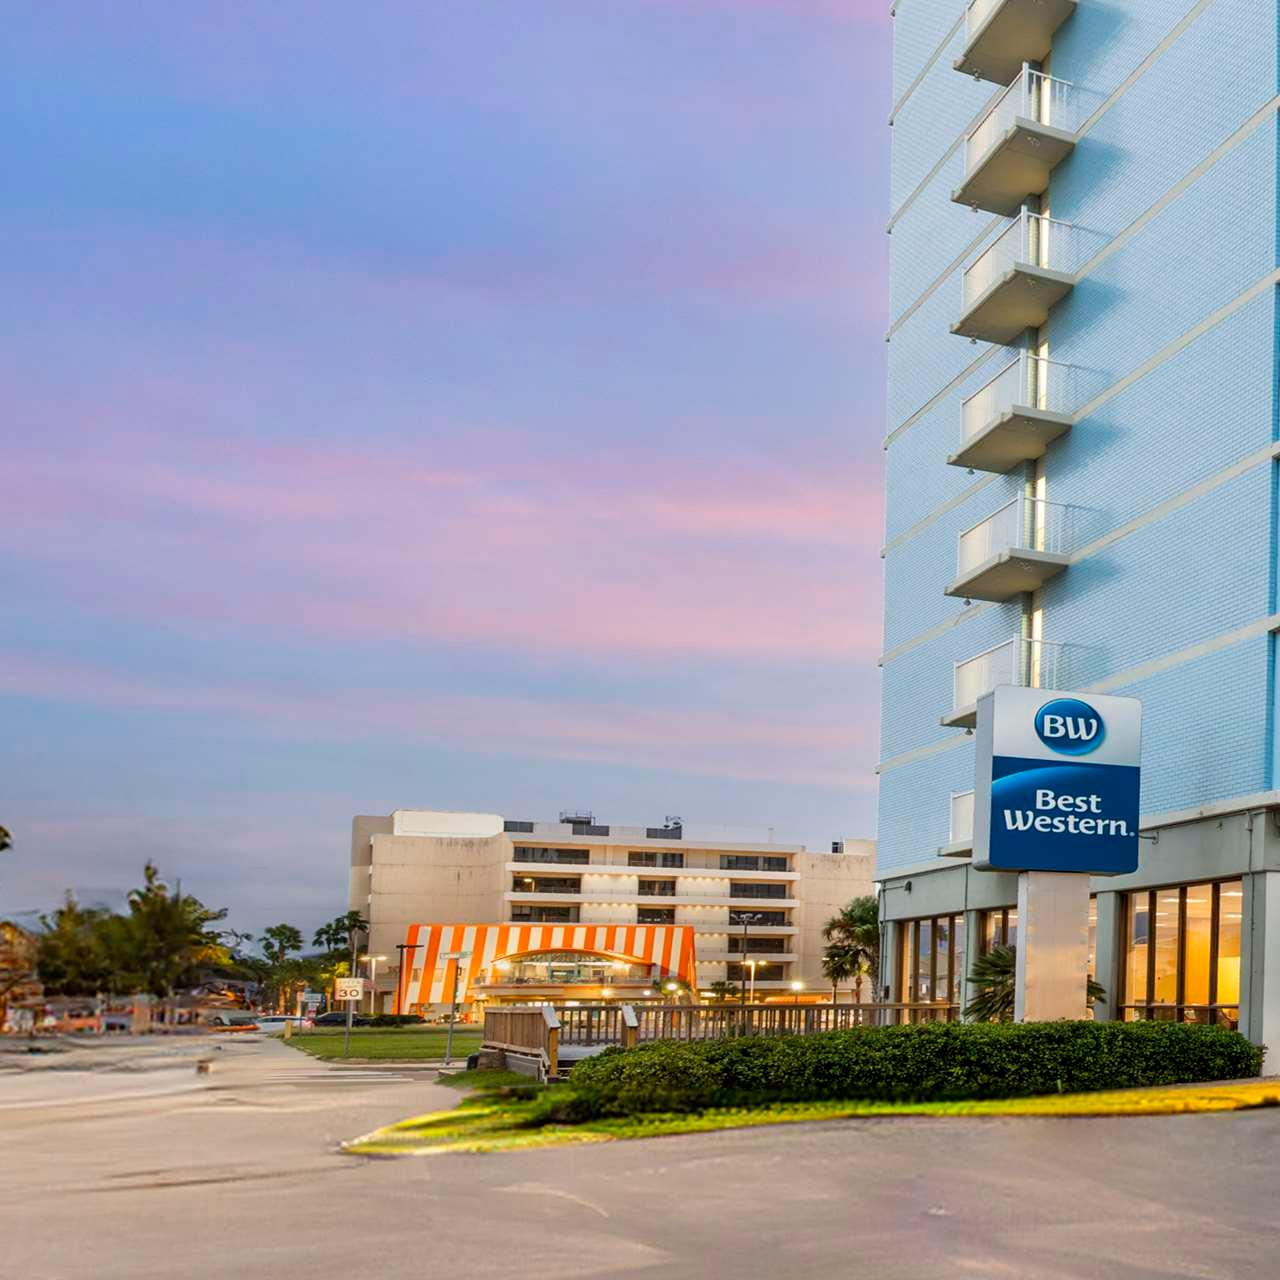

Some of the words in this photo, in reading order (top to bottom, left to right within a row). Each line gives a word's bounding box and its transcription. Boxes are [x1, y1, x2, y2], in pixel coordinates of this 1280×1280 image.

[1043, 714, 1098, 741] BW
[1035, 789, 1102, 814] Best
[338, 989, 360, 998] 30
